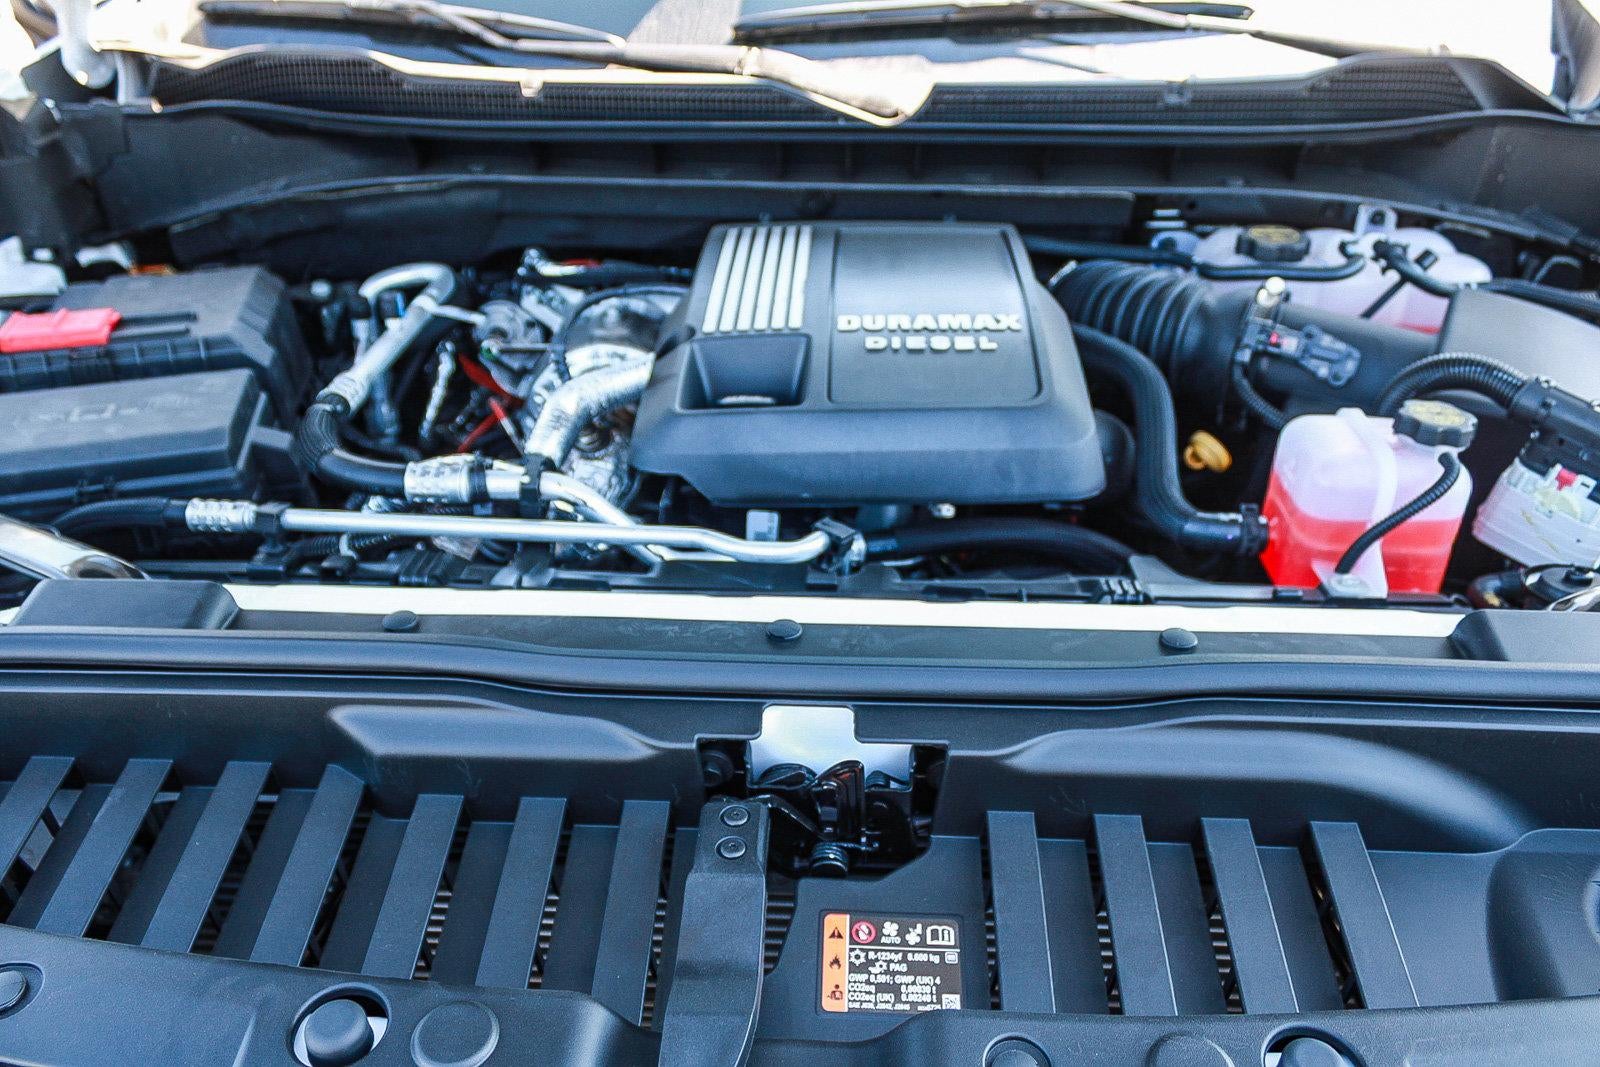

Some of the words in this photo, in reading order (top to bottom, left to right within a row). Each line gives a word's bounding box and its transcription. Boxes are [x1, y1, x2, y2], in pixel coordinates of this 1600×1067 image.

[837, 313, 1022, 331] DURAMAX
[865, 335, 999, 350] DIESEL
[880, 936, 901, 944] AUTO
[868, 951, 903, 962] R-1234yf
[929, 954, 940, 964] kg
[889, 963, 908, 972] PAG
[848, 974, 869, 982] GWP
[894, 975, 915, 983] GWP
[916, 976, 934, 986] (UK)
[934, 976, 941, 985] 4
[848, 983, 875, 993] CO2eq
[932, 986, 937, 994] t
[848, 992, 875, 1003] CO2eq
[876, 993, 895, 1003] (UK)
[932, 994, 937, 1003] t
